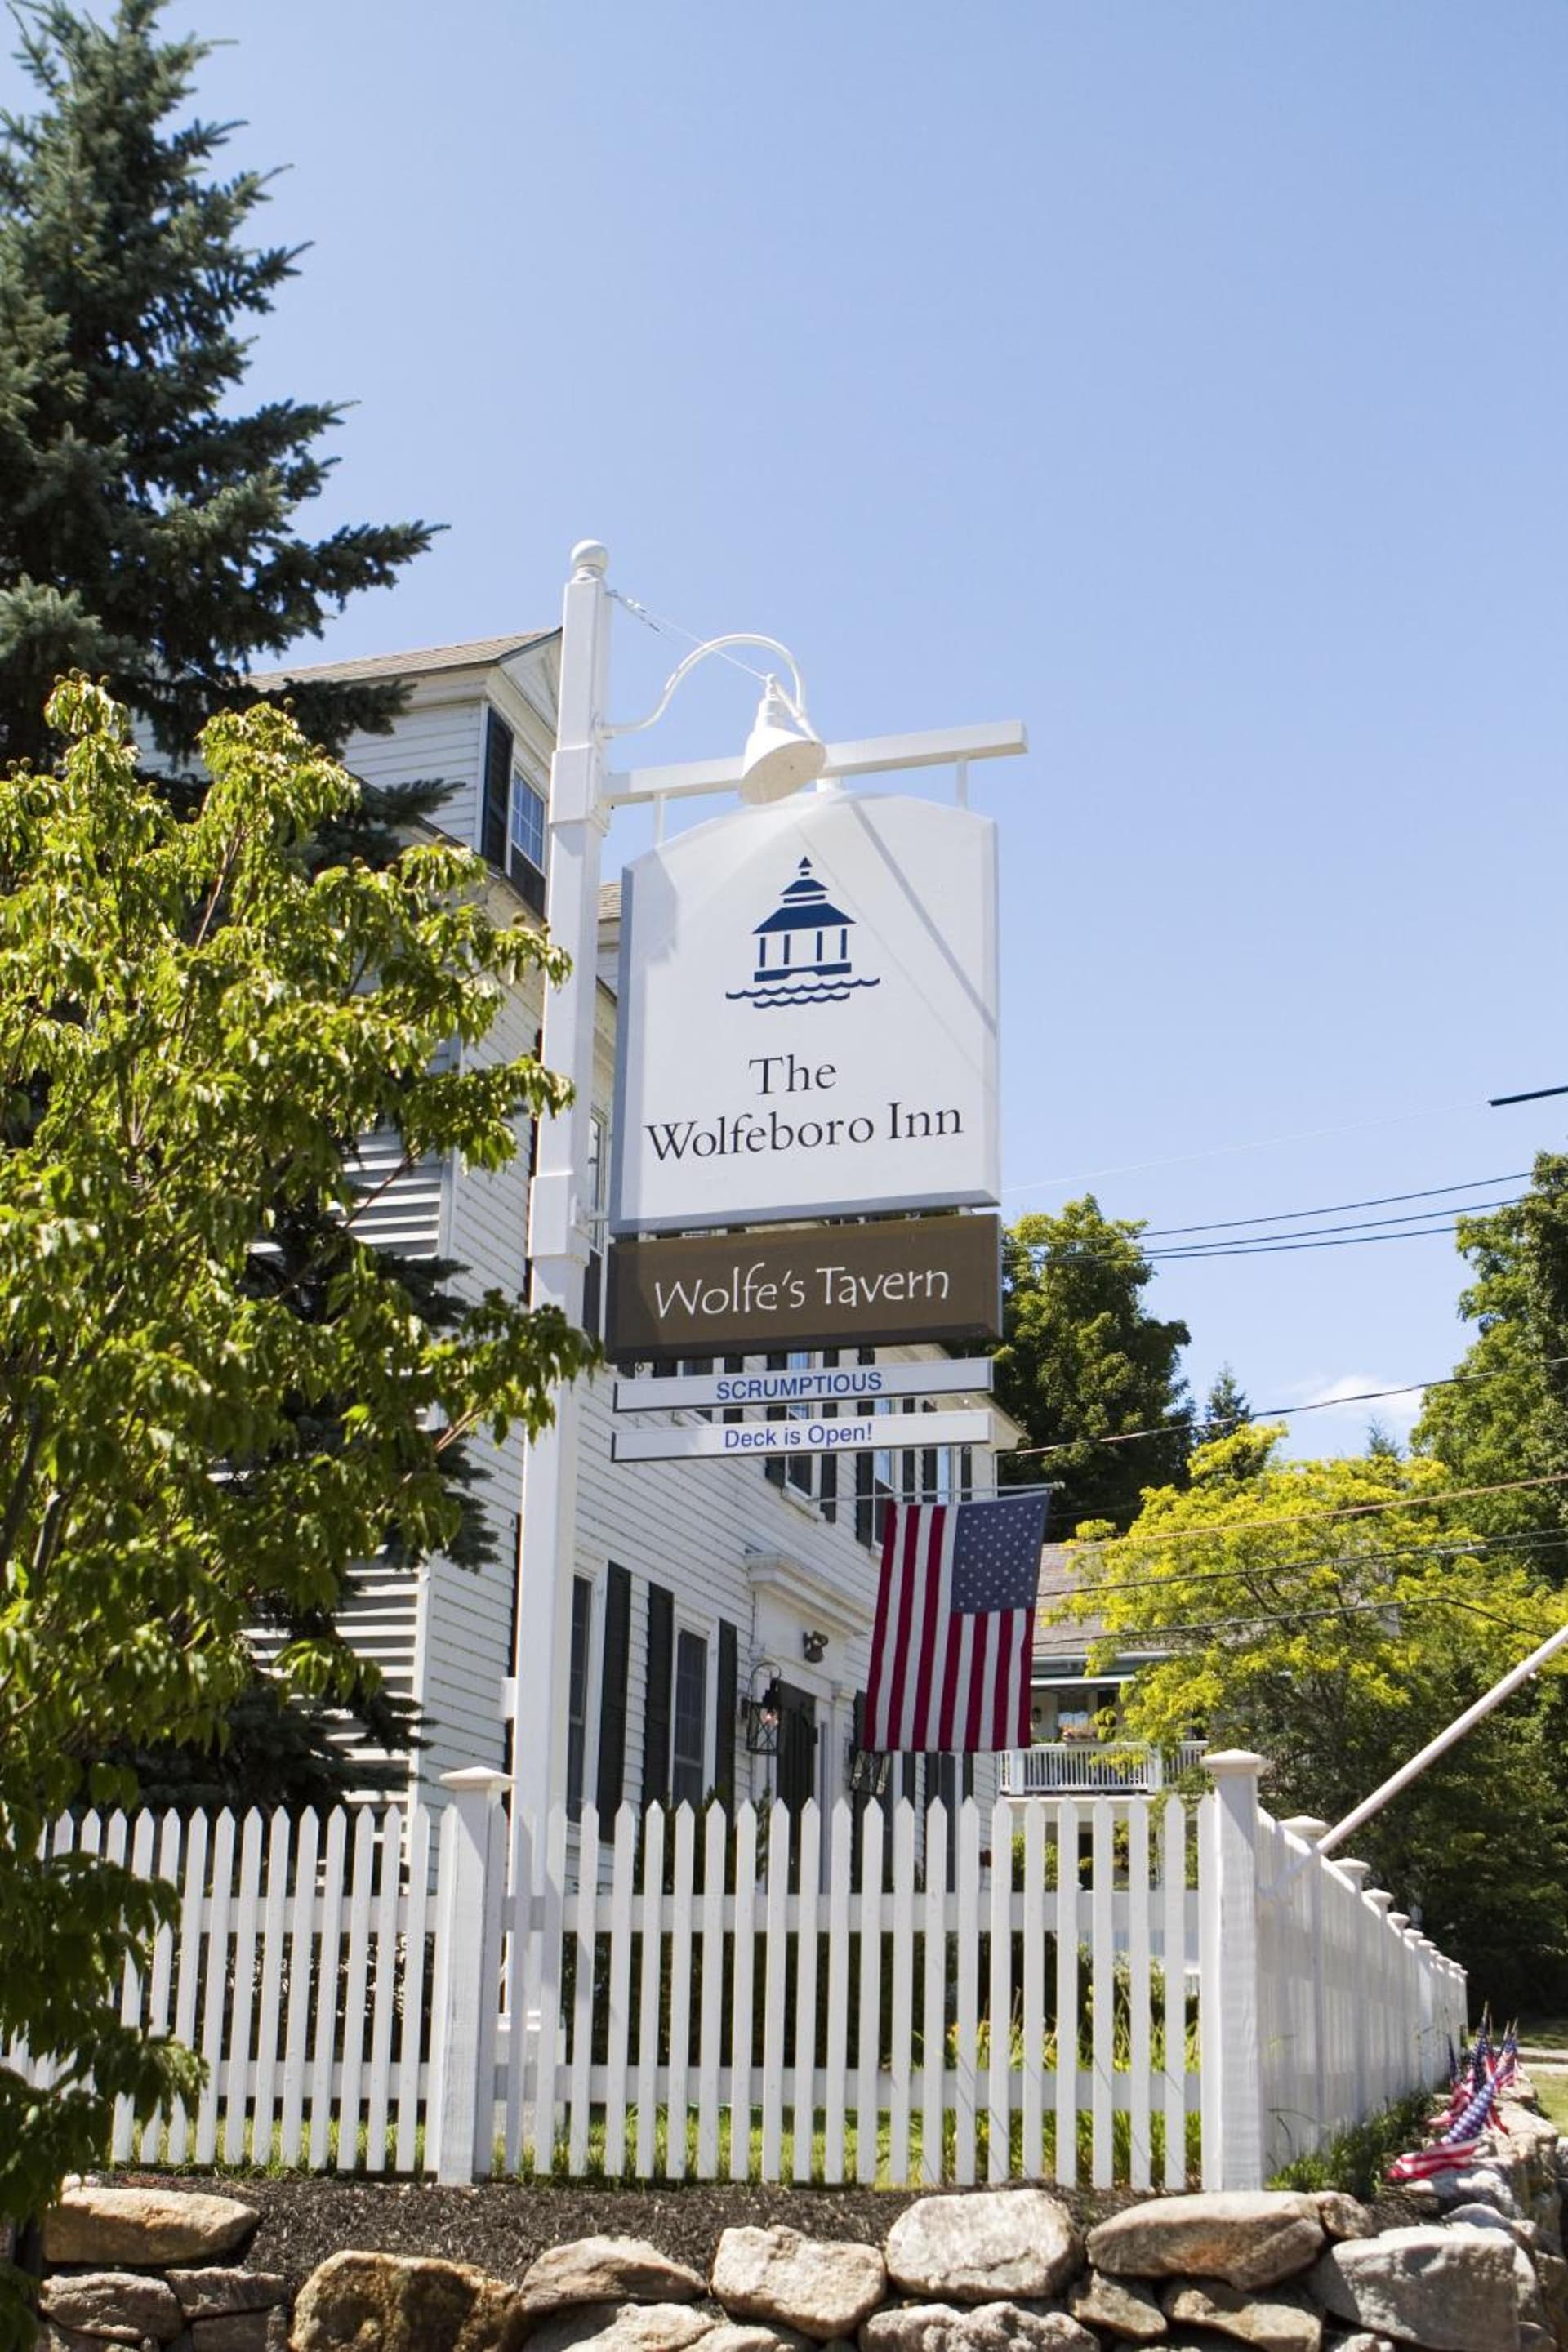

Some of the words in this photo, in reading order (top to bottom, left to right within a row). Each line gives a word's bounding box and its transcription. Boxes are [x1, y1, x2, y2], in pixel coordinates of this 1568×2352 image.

[749, 1054, 838, 1096] The
[643, 1111, 875, 1161] Wolfeboro
[887, 1102, 965, 1140] Inn
[654, 1262, 805, 1318] Wolfe's
[816, 1267, 950, 1307] Tavern
[716, 1372, 883, 1401] SCRUMPTIOUS
[724, 1428, 776, 1448] Deck
[784, 1426, 800, 1445] is
[808, 1423, 872, 1448] Open!
